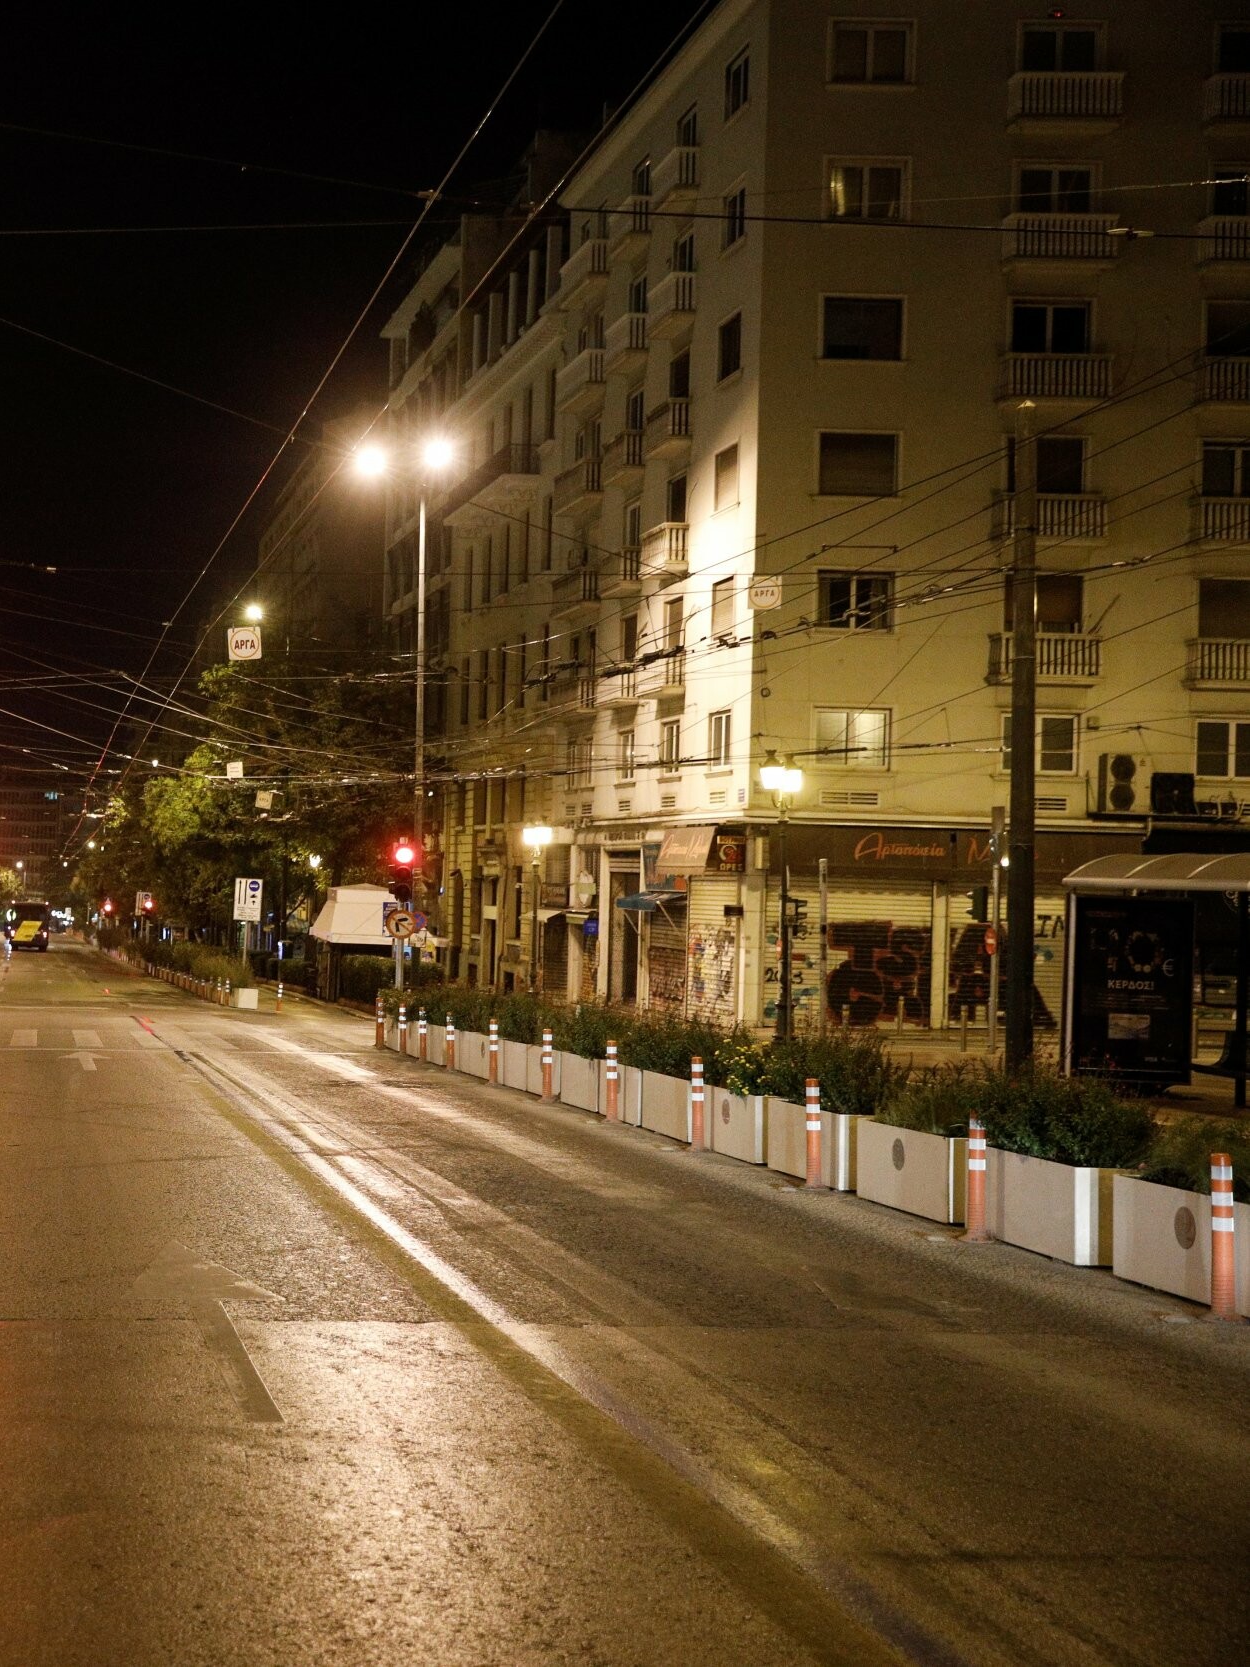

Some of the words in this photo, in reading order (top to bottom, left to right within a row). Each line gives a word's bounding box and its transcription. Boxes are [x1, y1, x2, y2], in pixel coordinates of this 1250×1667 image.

[754, 589, 775, 598] ΑΡΓΑ
[234, 639, 256, 650] ΑΡΓΑ
[719, 862, 743, 871] ΩΡΕΣ
[1107, 979, 1155, 991] ΚΕΡΔΟΣ!
